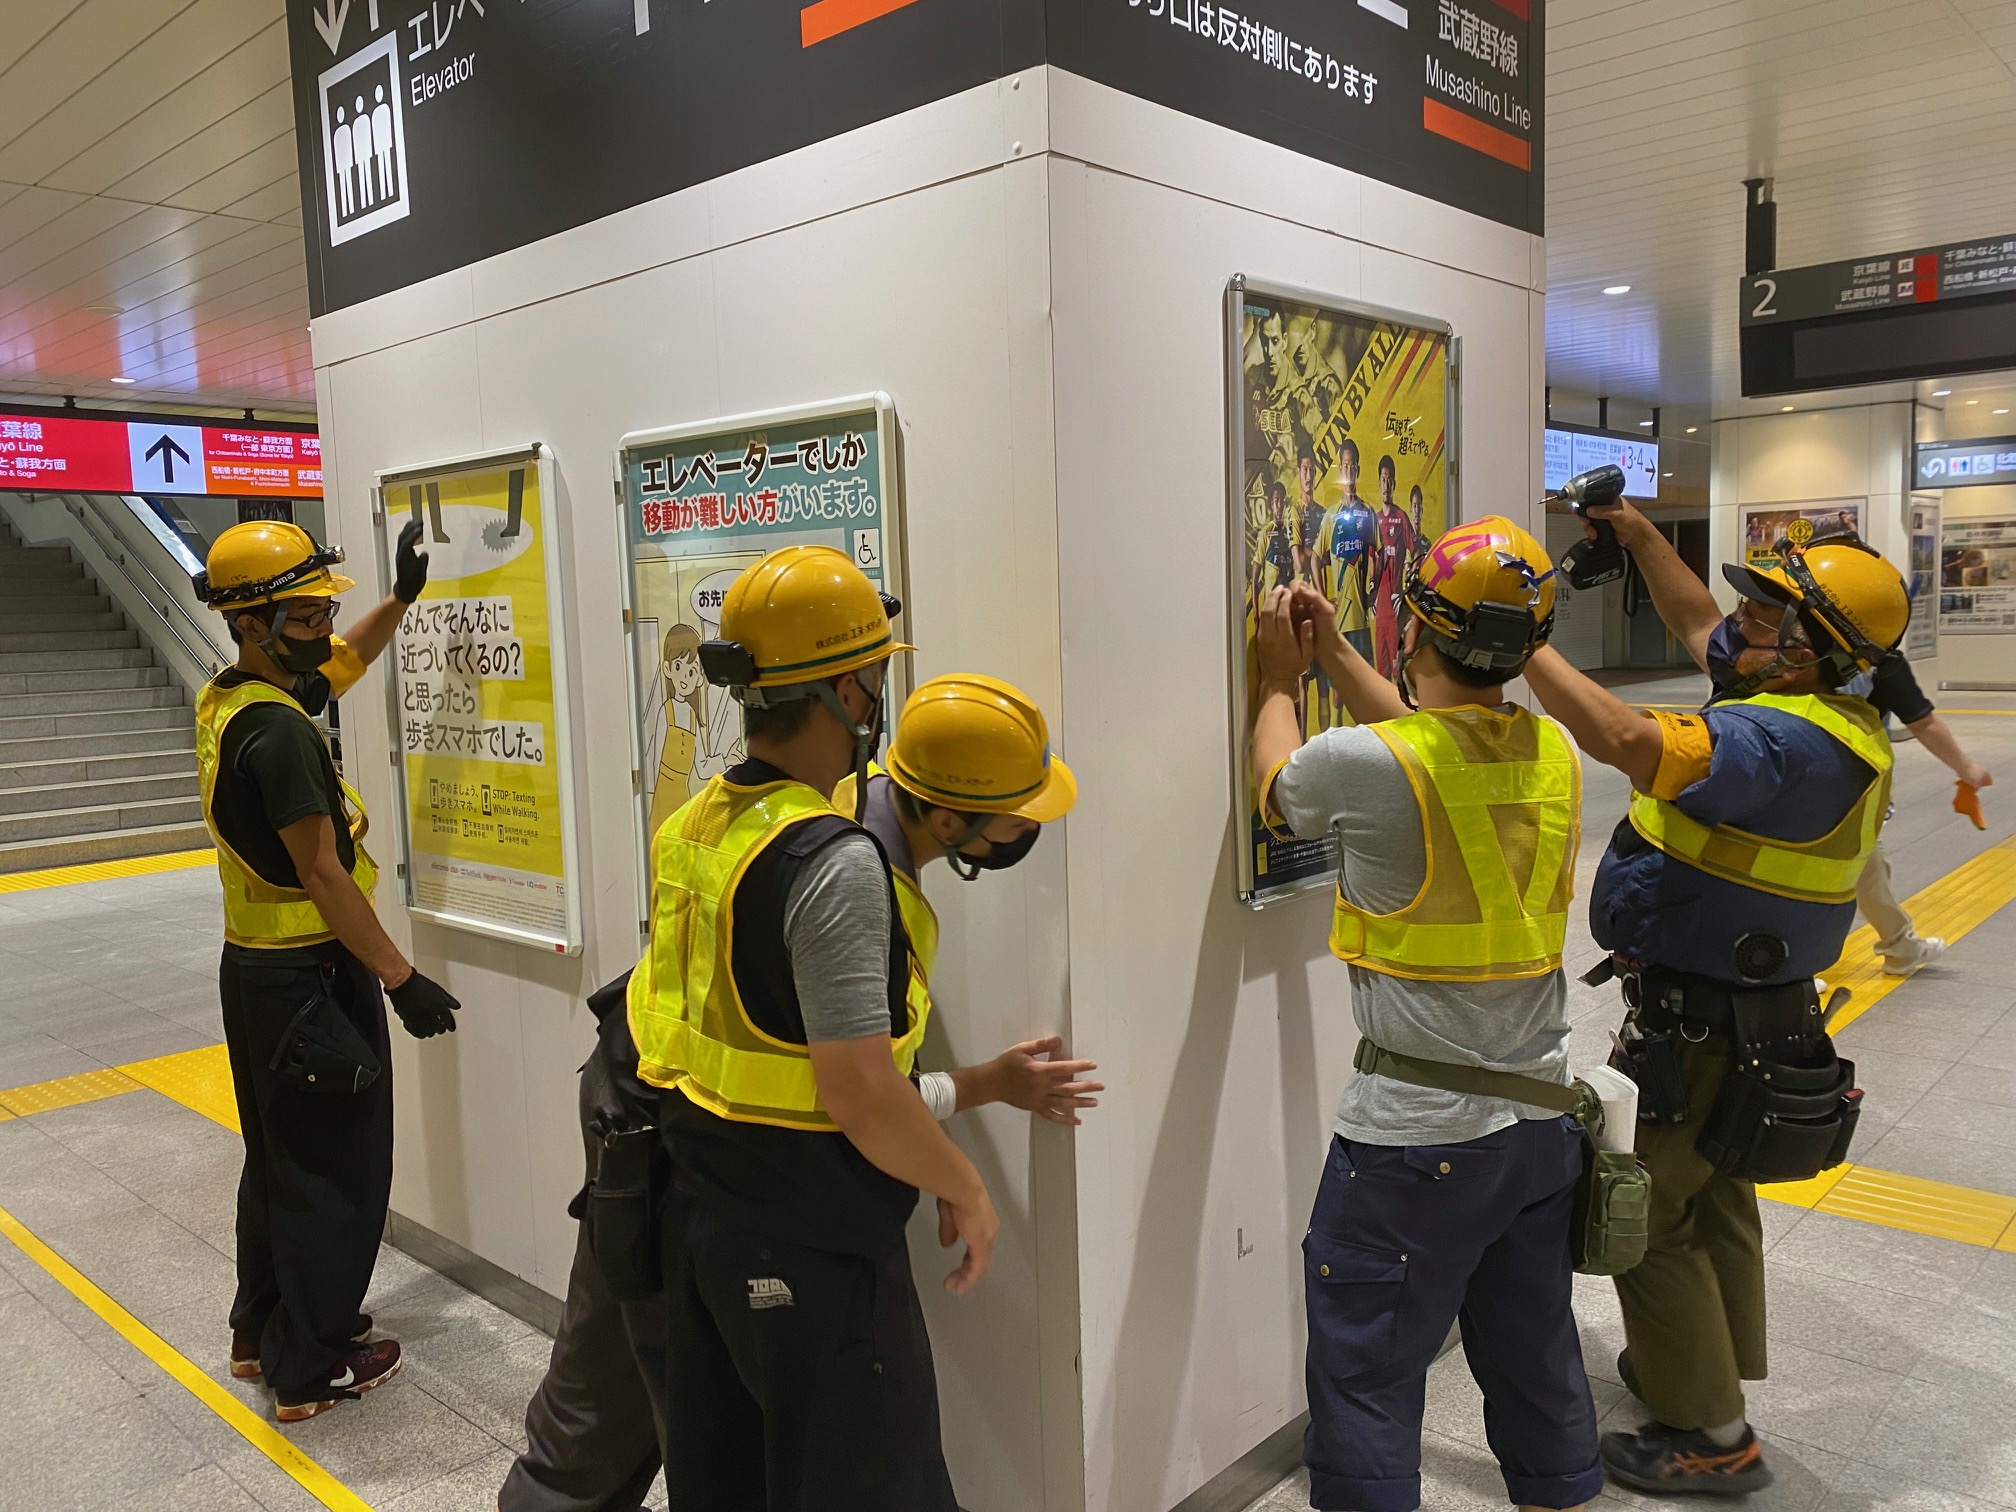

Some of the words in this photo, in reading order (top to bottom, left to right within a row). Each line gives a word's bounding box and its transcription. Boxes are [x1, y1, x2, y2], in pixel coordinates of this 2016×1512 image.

[1438, 0, 1519, 77] 武蔵野線
[410, 52, 475, 107] Elevator
[1426, 53, 1501, 117] Musashino
[1504, 92, 1531, 130] Line
[1852, 260, 1891, 277] 京葉線
[1751, 278, 1777, 318] 2
[1840, 284, 1891, 302] 武蔵野線
[0, 420, 43, 440] 葉線
[18, 441, 44, 453] Line
[17, 469, 37, 479] Soga
[641, 432, 868, 495] エレベーターでしか
[641, 477, 878, 535] 移動が難しい方がいます。
[400, 641, 522, 676] 近づいてくるの?
[403, 681, 477, 716] と思ったら
[405, 718, 543, 763] 歩きスマホでした。
[440, 781, 479, 799] やめましょう、
[492, 788, 512, 801] STOP:
[512, 790, 536, 807] Texting
[440, 796, 478, 814] 歩きスマホ。
[493, 803, 512, 816] While
[512, 805, 541, 822] Walking.
